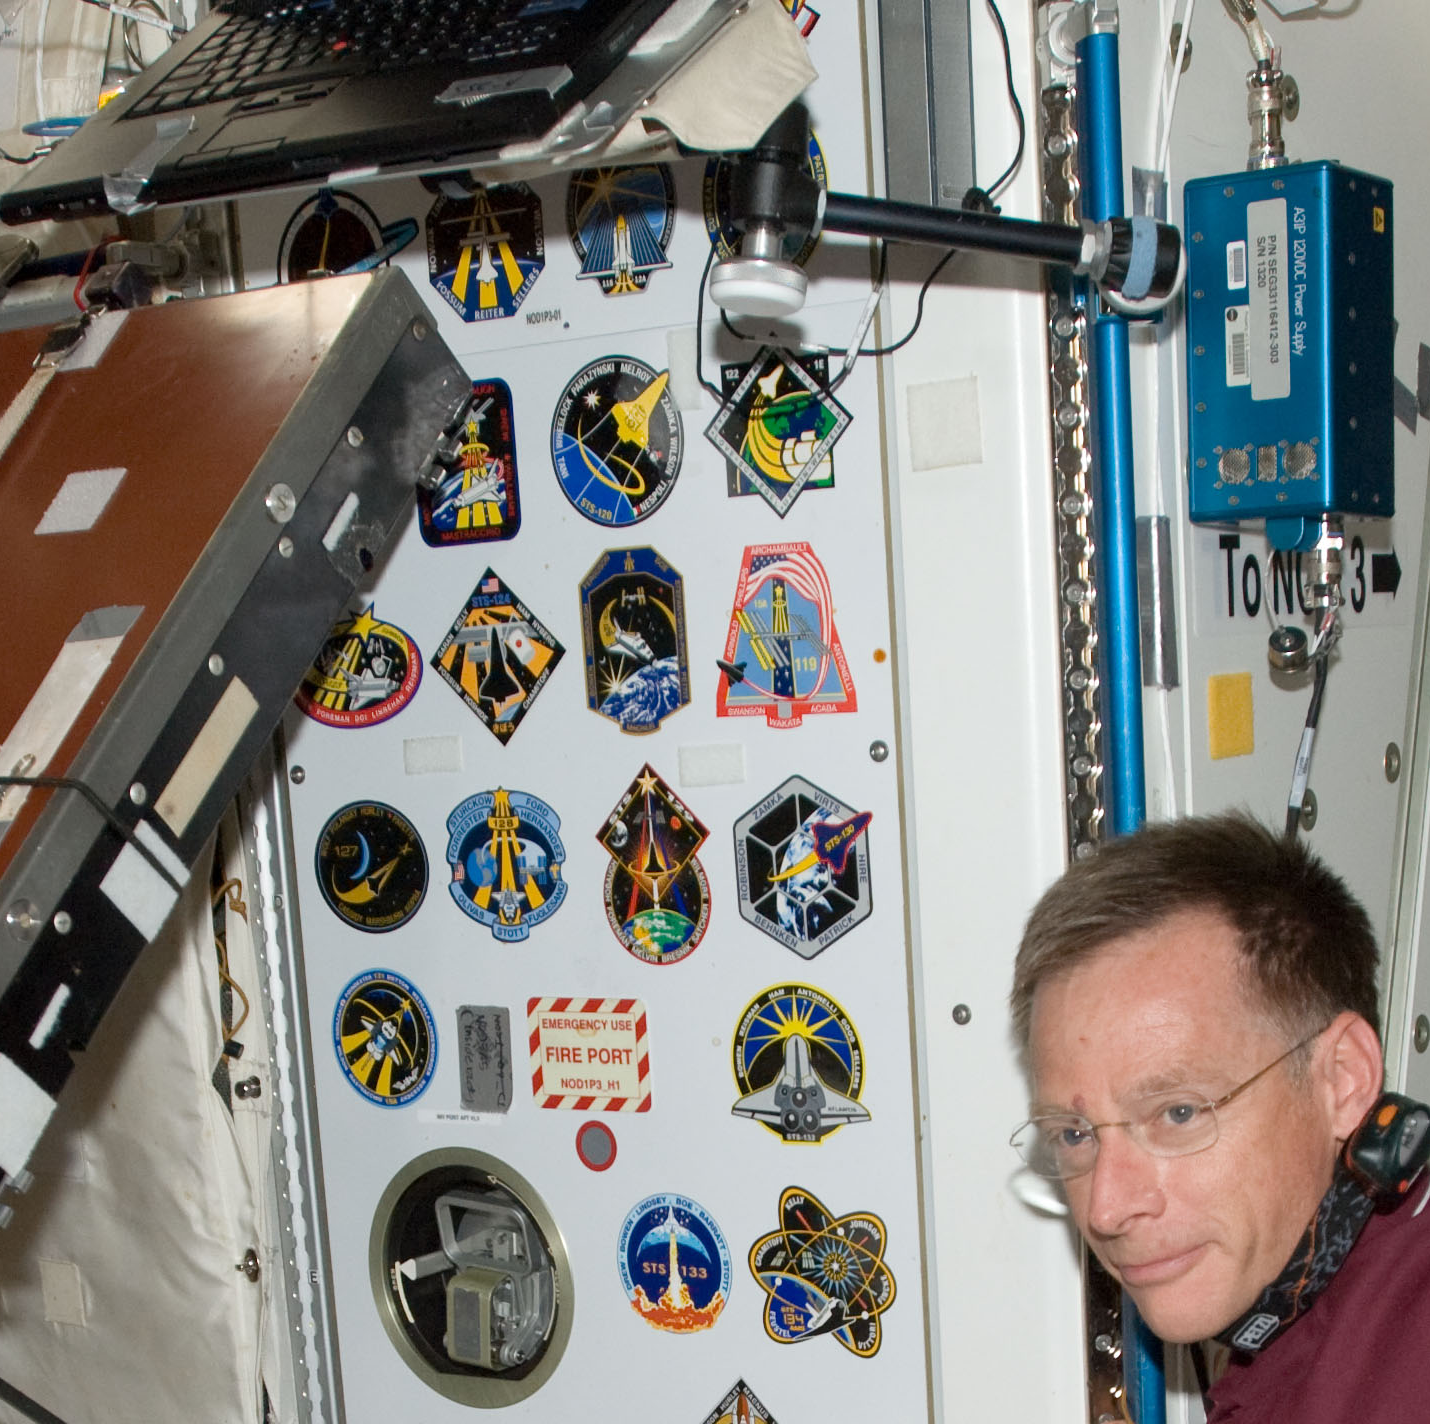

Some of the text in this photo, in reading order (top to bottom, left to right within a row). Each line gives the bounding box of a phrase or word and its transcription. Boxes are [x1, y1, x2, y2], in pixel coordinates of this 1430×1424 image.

[1267, 235, 1277, 254] P/N
[1293, 239, 1306, 280] 120VDC
[1256, 236, 1267, 288] S/N 1320
[436, 267, 540, 321] FOSSUM REITER SELLERS
[1294, 283, 1306, 318] Power
[526, 310, 562, 325] NOD1P3-01
[1292, 321, 1306, 357] Supply
[725, 368, 740, 380] 122
[555, 362, 667, 513] WHEELOCK PARAZYNSKI MELROY NESPOLI
[580, 498, 613, 520] STS-120
[750, 543, 808, 554] ARCHAMBAULT
[1219, 534, 1365, 617] To 3
[472, 593, 511, 607] STS-124
[437, 608, 470, 659] GARAN KELLY
[516, 603, 557, 648] HAM NYBERG
[727, 620, 739, 659] ARNOLD
[794, 657, 817, 672] 119
[832, 643, 853, 692] ANTONELLI
[438, 667, 489, 724] FOSSUM HOSHIDE
[522, 668, 551, 710] CHAMITOFF
[728, 706, 766, 716] SWANSON
[769, 717, 801, 727] WAKATA
[810, 704, 838, 714] ACABA
[449, 796, 549, 828] STURCKOW FORD
[752, 792, 841, 820] ZAMKA VIRTS
[450, 809, 563, 858] FORRESTER HERNANDEZ
[492, 819, 514, 829] 128
[824, 823, 856, 853] STS-130
[335, 845, 358, 857] 127
[737, 839, 748, 901] ROBINSON
[858, 854, 867, 884] HIRE
[457, 882, 565, 938] OLIVAS STOTT FUGLESANG
[754, 915, 798, 948] BEHNKEN
[818, 914, 855, 946] PATRICK
[542, 1018, 633, 1031] EMERGENCY USE
[739, 988, 855, 1043] REISMAN HAM ANTONELLI GOOD
[546, 1047, 632, 1065] FIRE PORT
[561, 1078, 620, 1092] NOD1P3_H1
[784, 1196, 806, 1210] KELLY
[620, 1218, 634, 1253] BOWEN
[635, 1197, 667, 1217] LINDSEY
[676, 1197, 693, 1209] BOE
[699, 1210, 726, 1251] BARRATT
[849, 1220, 881, 1241] JOHNSON
[755, 1237, 784, 1267] CHAMITOFF
[642, 1262, 708, 1279] STS 133
[769, 1310, 792, 1338] FEUSTEL
[783, 1314, 805, 1325] 134
[857, 1321, 877, 1350] VITTORI
[720, 1386, 741, 1411] HURLEY
[743, 1387, 769, 1419] MAGNUS
